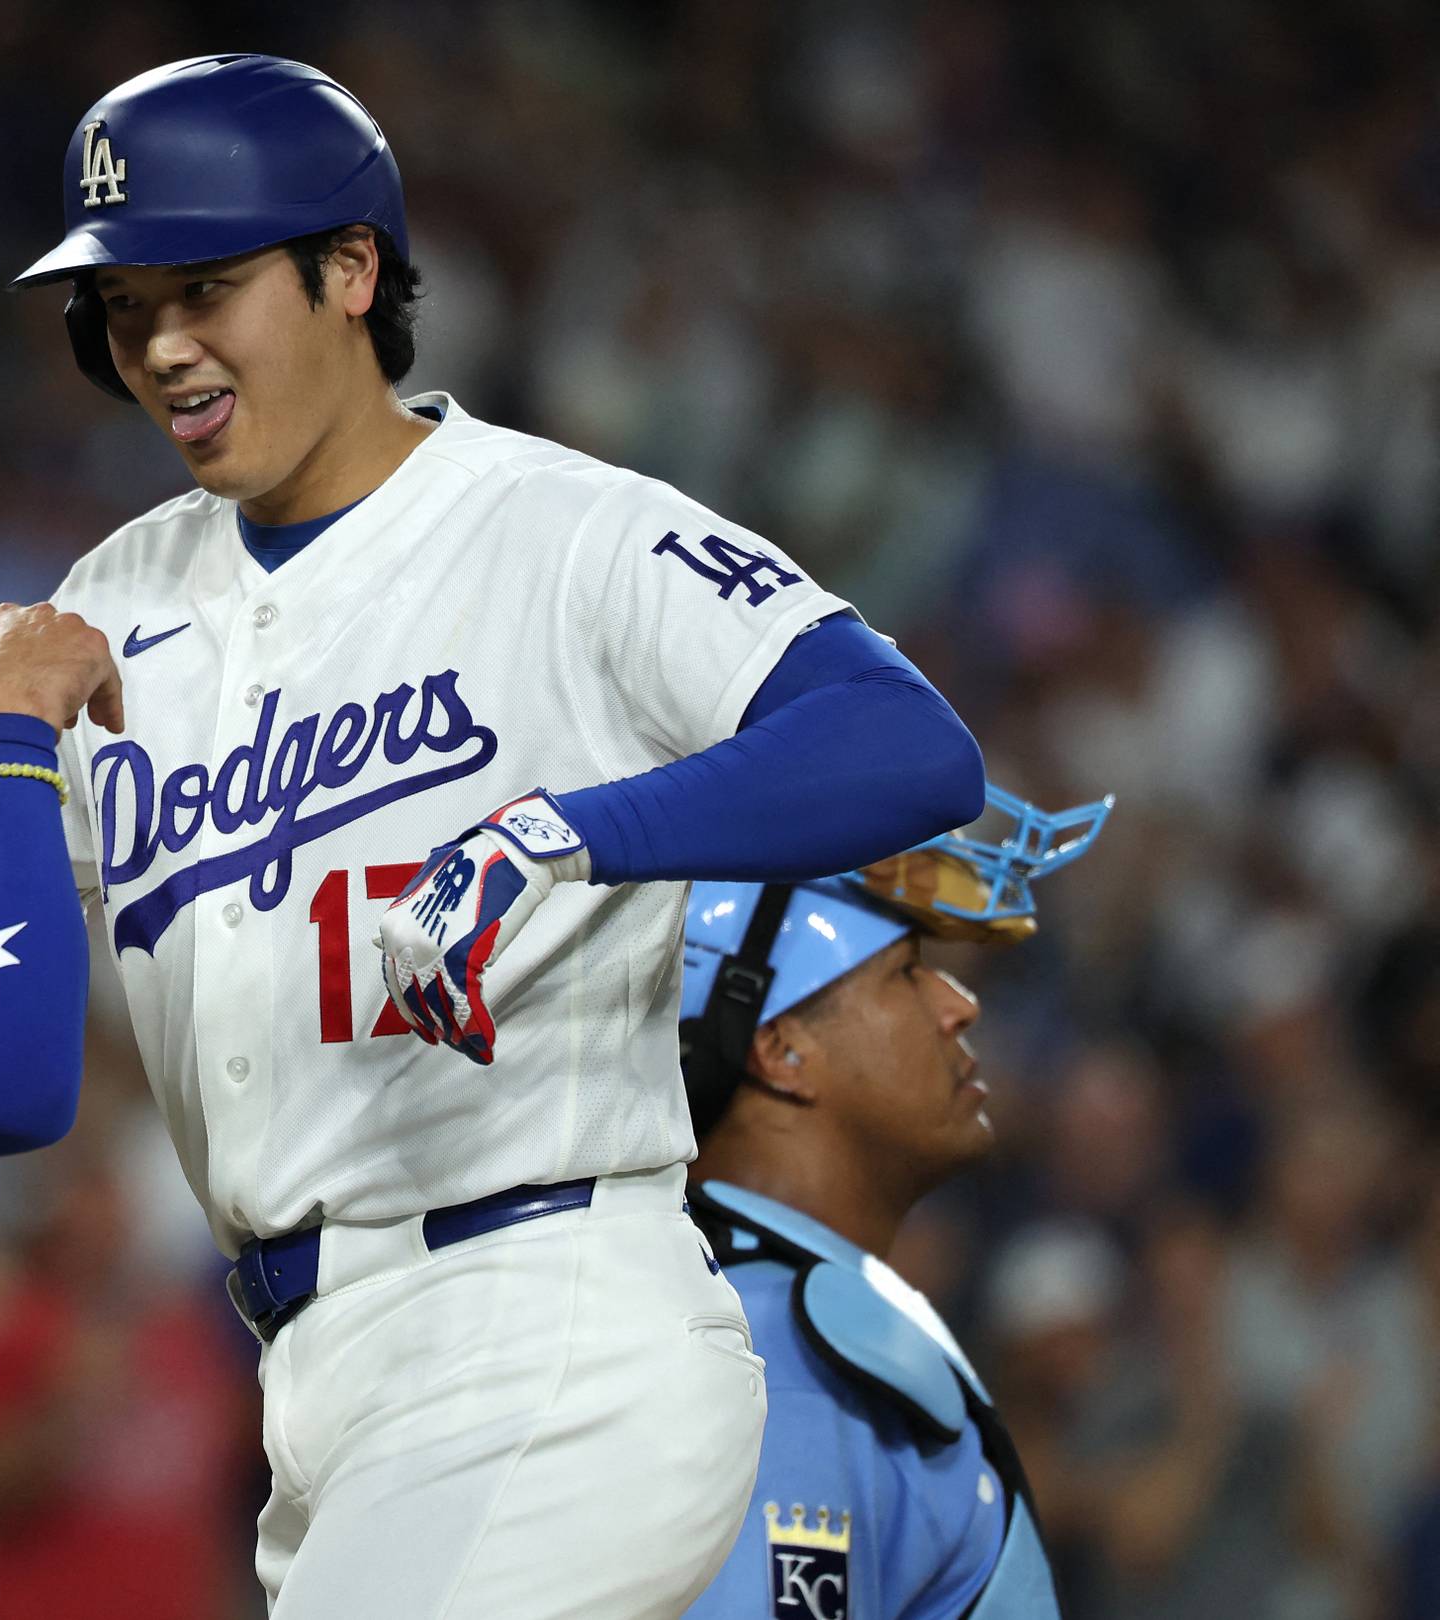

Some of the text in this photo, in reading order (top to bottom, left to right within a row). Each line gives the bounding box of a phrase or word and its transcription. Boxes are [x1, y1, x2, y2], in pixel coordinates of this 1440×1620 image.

[80, 120, 126, 208] LA
[650, 530, 804, 608] LA
[91, 668, 498, 912] Dodgers
[774, 1552, 845, 1620] KC
